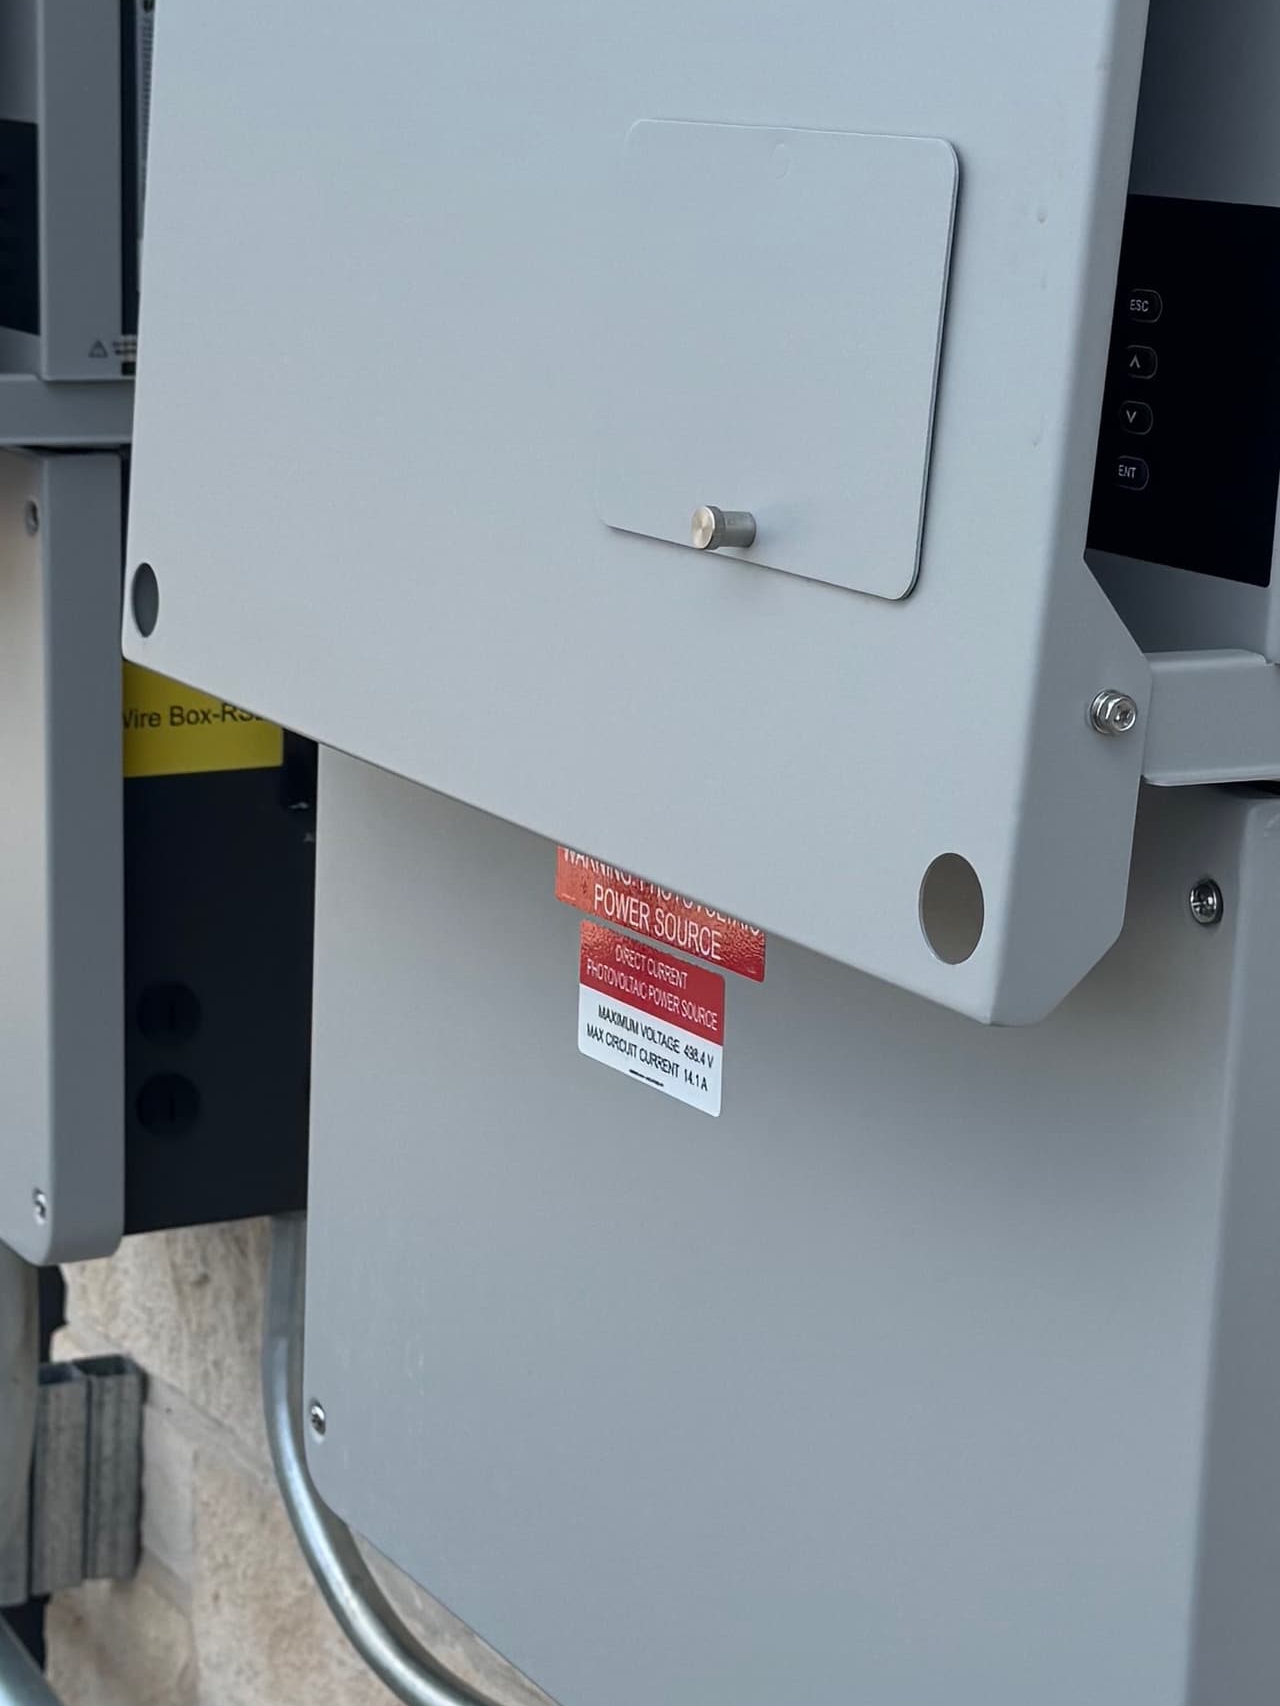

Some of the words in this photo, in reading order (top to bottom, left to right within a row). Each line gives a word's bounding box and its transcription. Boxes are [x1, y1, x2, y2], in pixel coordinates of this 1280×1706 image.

[1130, 299, 1149, 312] ESC
[594, 882, 650, 931] POWER
[653, 907, 724, 961] SOURCE
[615, 943, 646, 972] DIRECT
[646, 956, 687, 990] CURRENT
[586, 957, 647, 1000] PHOTOVOLTAIC
[648, 984, 680, 1014] POWER
[681, 998, 717, 1031] SOURCE
[586, 1022, 603, 1043] MAX
[605, 1031, 637, 1058] CIRCUIT
[639, 1046, 679, 1078] CURRENT
[598, 1004, 638, 1035] MAXIMUM
[640, 1022, 680, 1054] VOLTAGE
